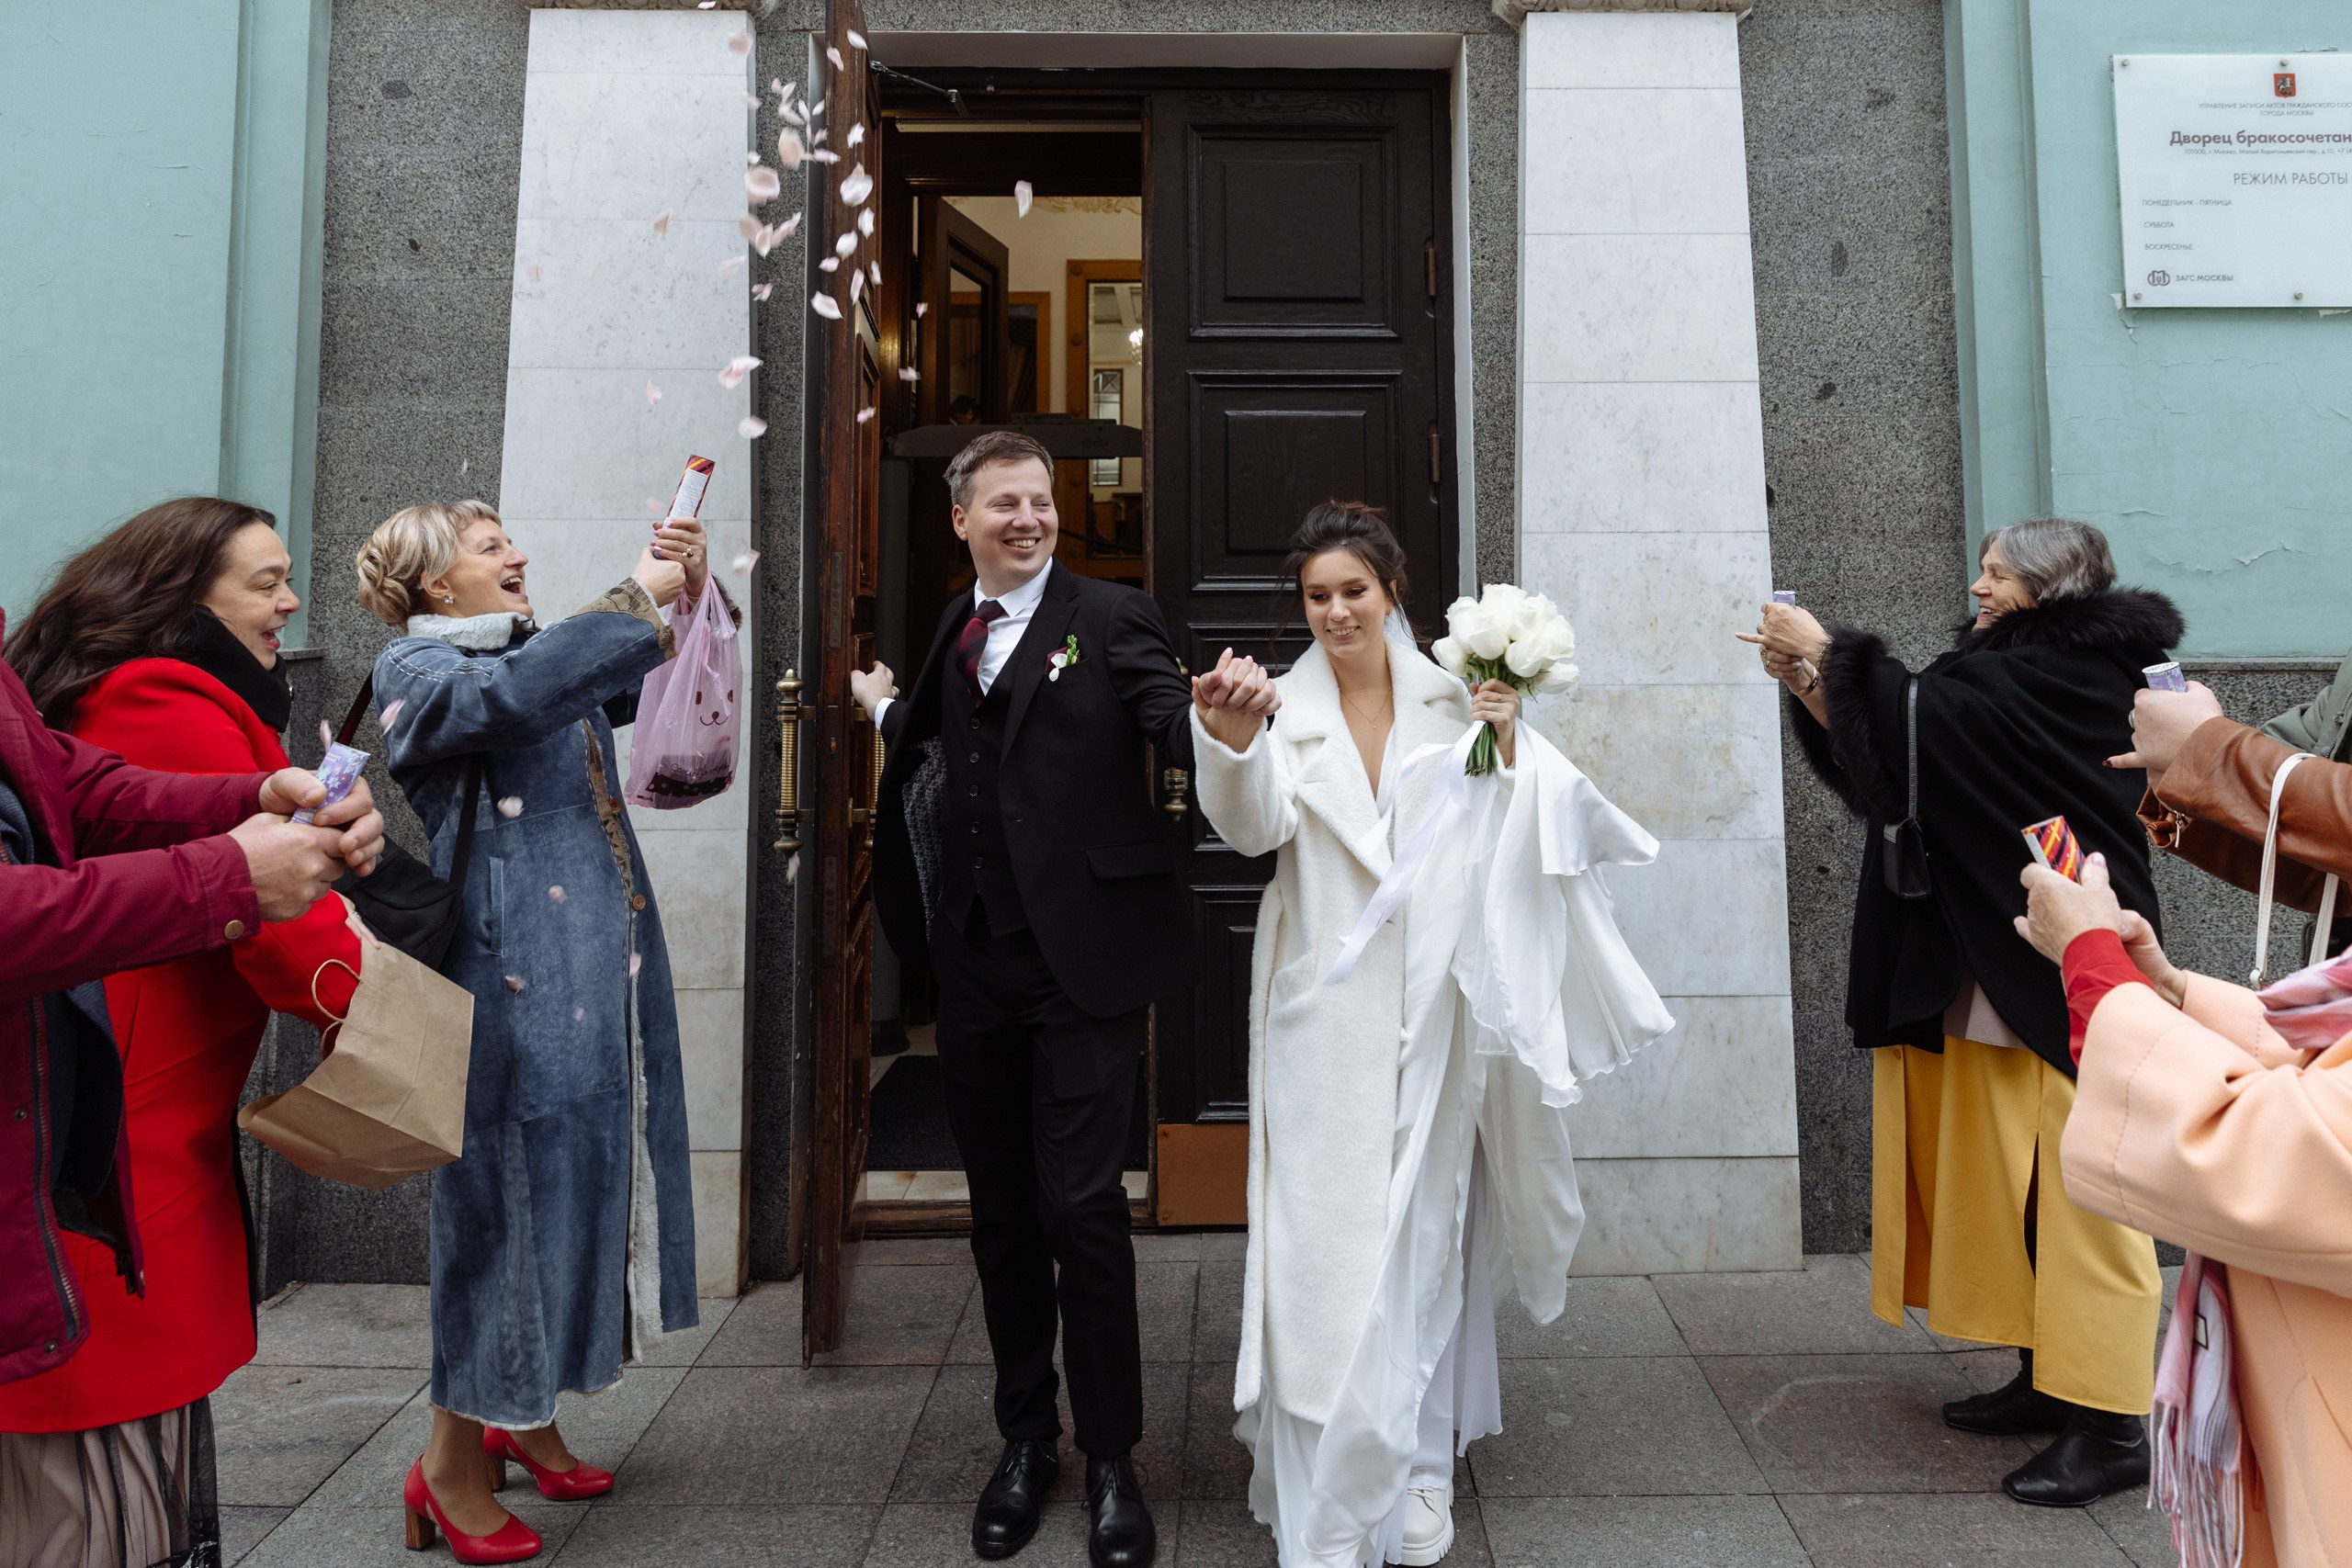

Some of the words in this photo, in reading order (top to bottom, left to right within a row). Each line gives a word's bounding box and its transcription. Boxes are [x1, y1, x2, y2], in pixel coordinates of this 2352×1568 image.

[2169, 130, 2233, 147] Дворец
[2233, 172, 2288, 186] РЕЖИМ
[2291, 171, 2348, 185] РАБОТЫ
[2142, 198, 2194, 207] ПОНЕДЕЛЬНИК
[2199, 198, 2233, 207] ПЯТНИЦА
[2175, 274, 2195, 282] ЗАГС
[2197, 274, 2234, 282] МОСКВЫ
